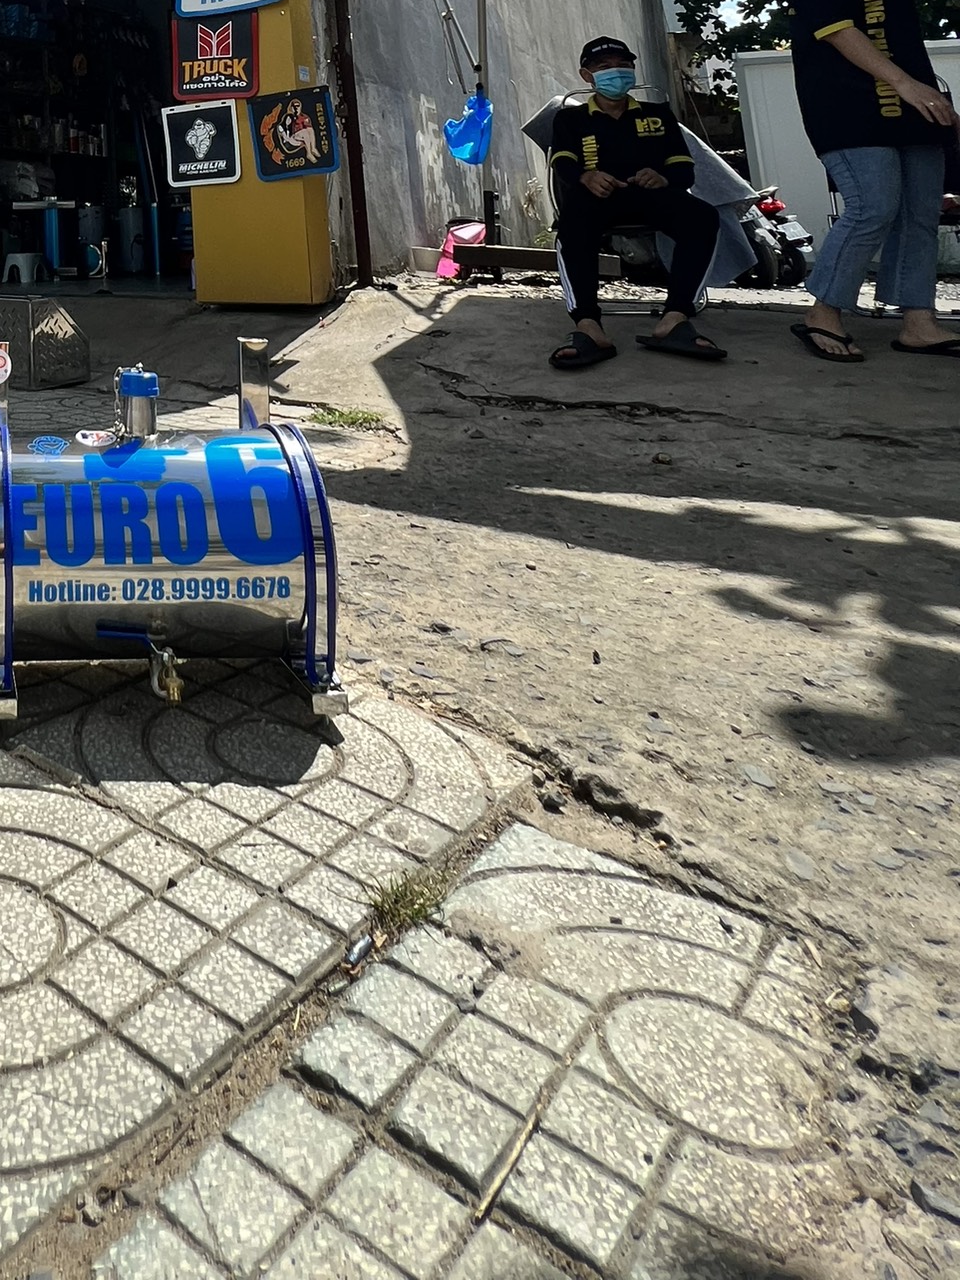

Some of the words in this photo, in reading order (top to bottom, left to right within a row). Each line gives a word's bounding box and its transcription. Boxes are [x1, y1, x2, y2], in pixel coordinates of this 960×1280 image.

[182, 57, 248, 83] TRUCK
[178, 159, 227, 173] MICHELIN
[285, 157, 306, 168] 1669
[11, 482, 209, 567] EURO
[204, 435, 305, 566] 6
[28, 578, 117, 603] Hotline:
[122, 575, 290, 601] 028.9999.6678
